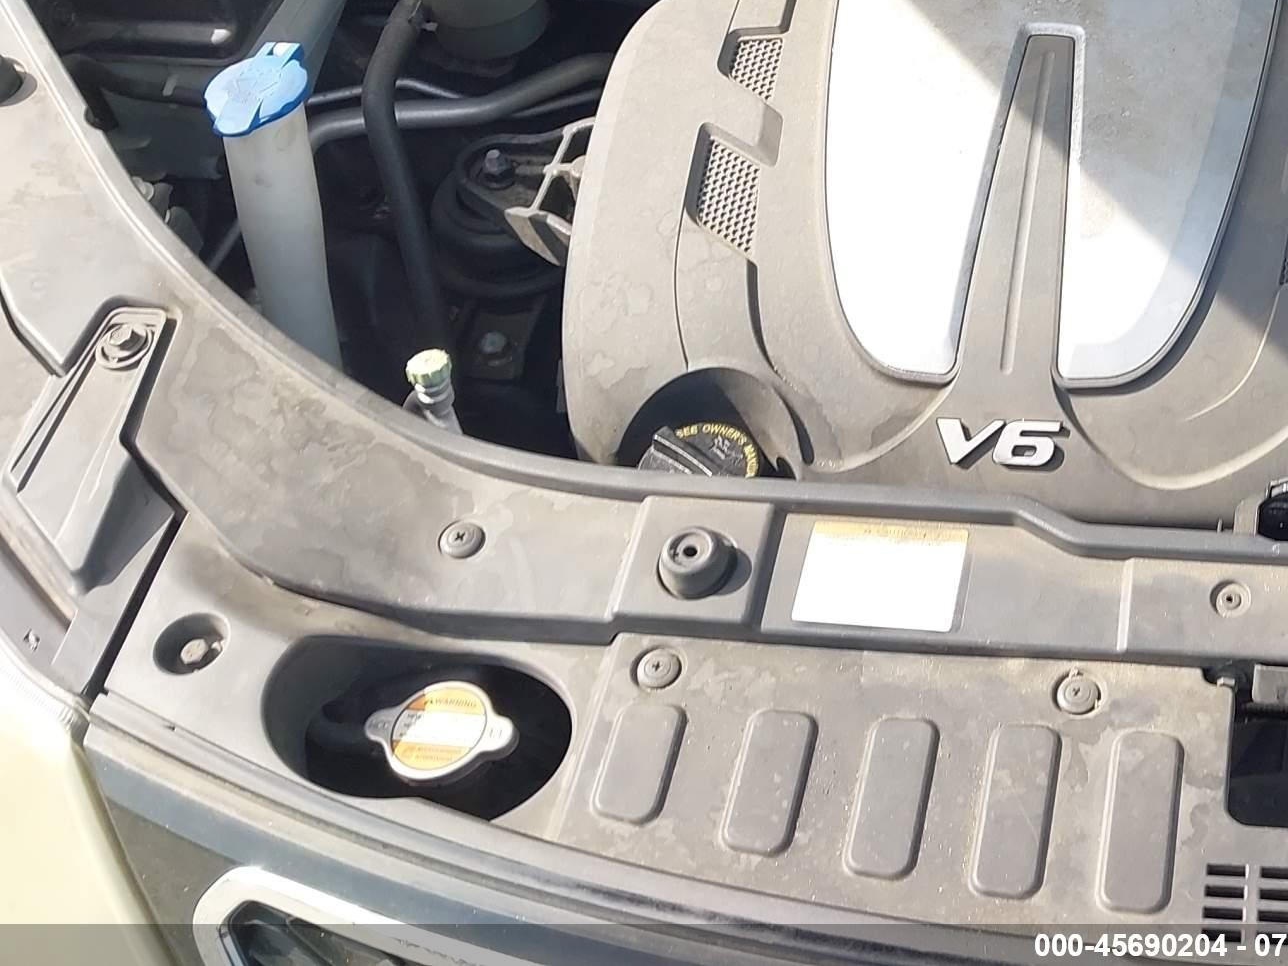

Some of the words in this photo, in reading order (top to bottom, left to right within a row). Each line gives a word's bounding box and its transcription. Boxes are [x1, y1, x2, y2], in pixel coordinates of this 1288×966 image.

[675, 424, 698, 439] SEE
[936, 417, 1062, 466] V6
[435, 697, 478, 708] WARNING
